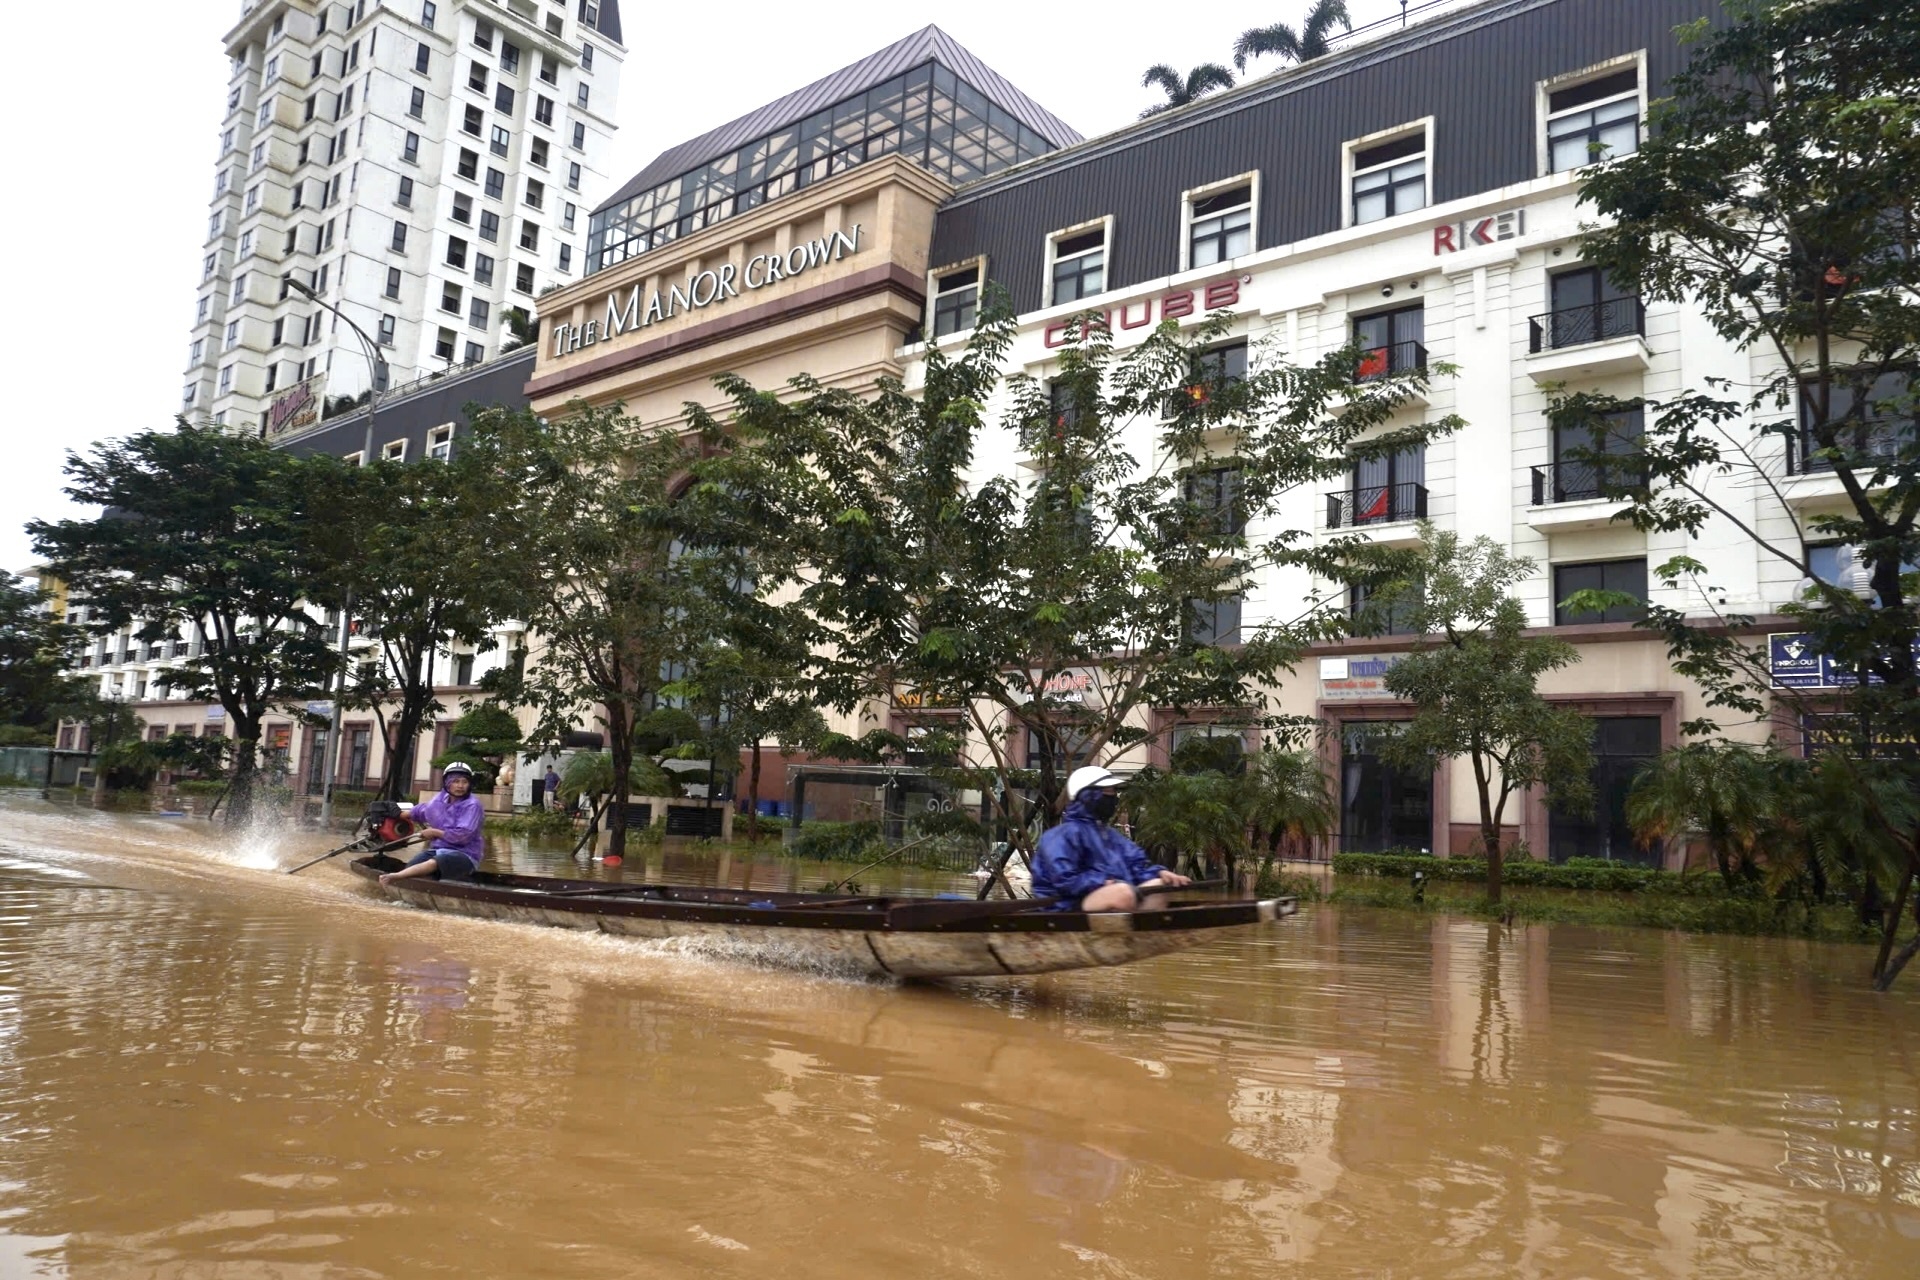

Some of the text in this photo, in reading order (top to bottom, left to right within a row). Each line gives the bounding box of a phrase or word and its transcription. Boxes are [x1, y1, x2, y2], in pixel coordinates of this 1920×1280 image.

[1434, 209, 1525, 256] RIKEI
[553, 223, 863, 358] THE MANOR CROWN
